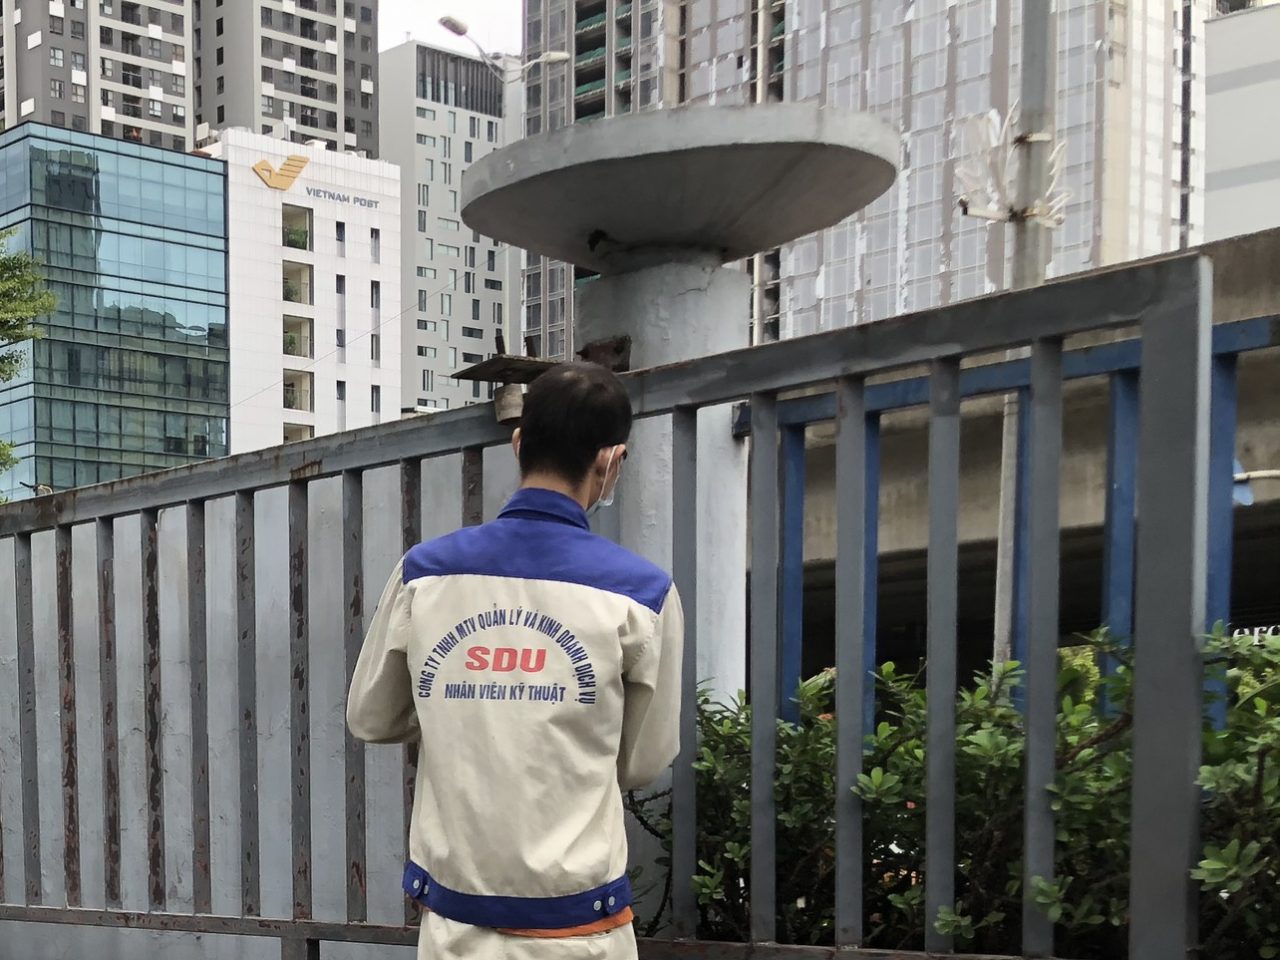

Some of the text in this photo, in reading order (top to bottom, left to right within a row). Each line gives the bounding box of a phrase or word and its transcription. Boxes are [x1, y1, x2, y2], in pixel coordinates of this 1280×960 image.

[306, 187, 379, 208] VIETNAM POST
[455, 617, 477, 640] MTV
[478, 603, 506, 630] QUẢN
[509, 606, 523, 626] LÝ
[537, 614, 563, 639] KINH
[432, 631, 459, 659] TNHH
[424, 655, 441, 670] TY
[465, 646, 547, 673] SDU
[572, 663, 597, 689] DỊCH
[444, 680, 476, 699] NHÂN
[479, 681, 507, 700] VIÊN
[528, 682, 567, 705] THUẬT
[574, 691, 596, 705] VỤ
